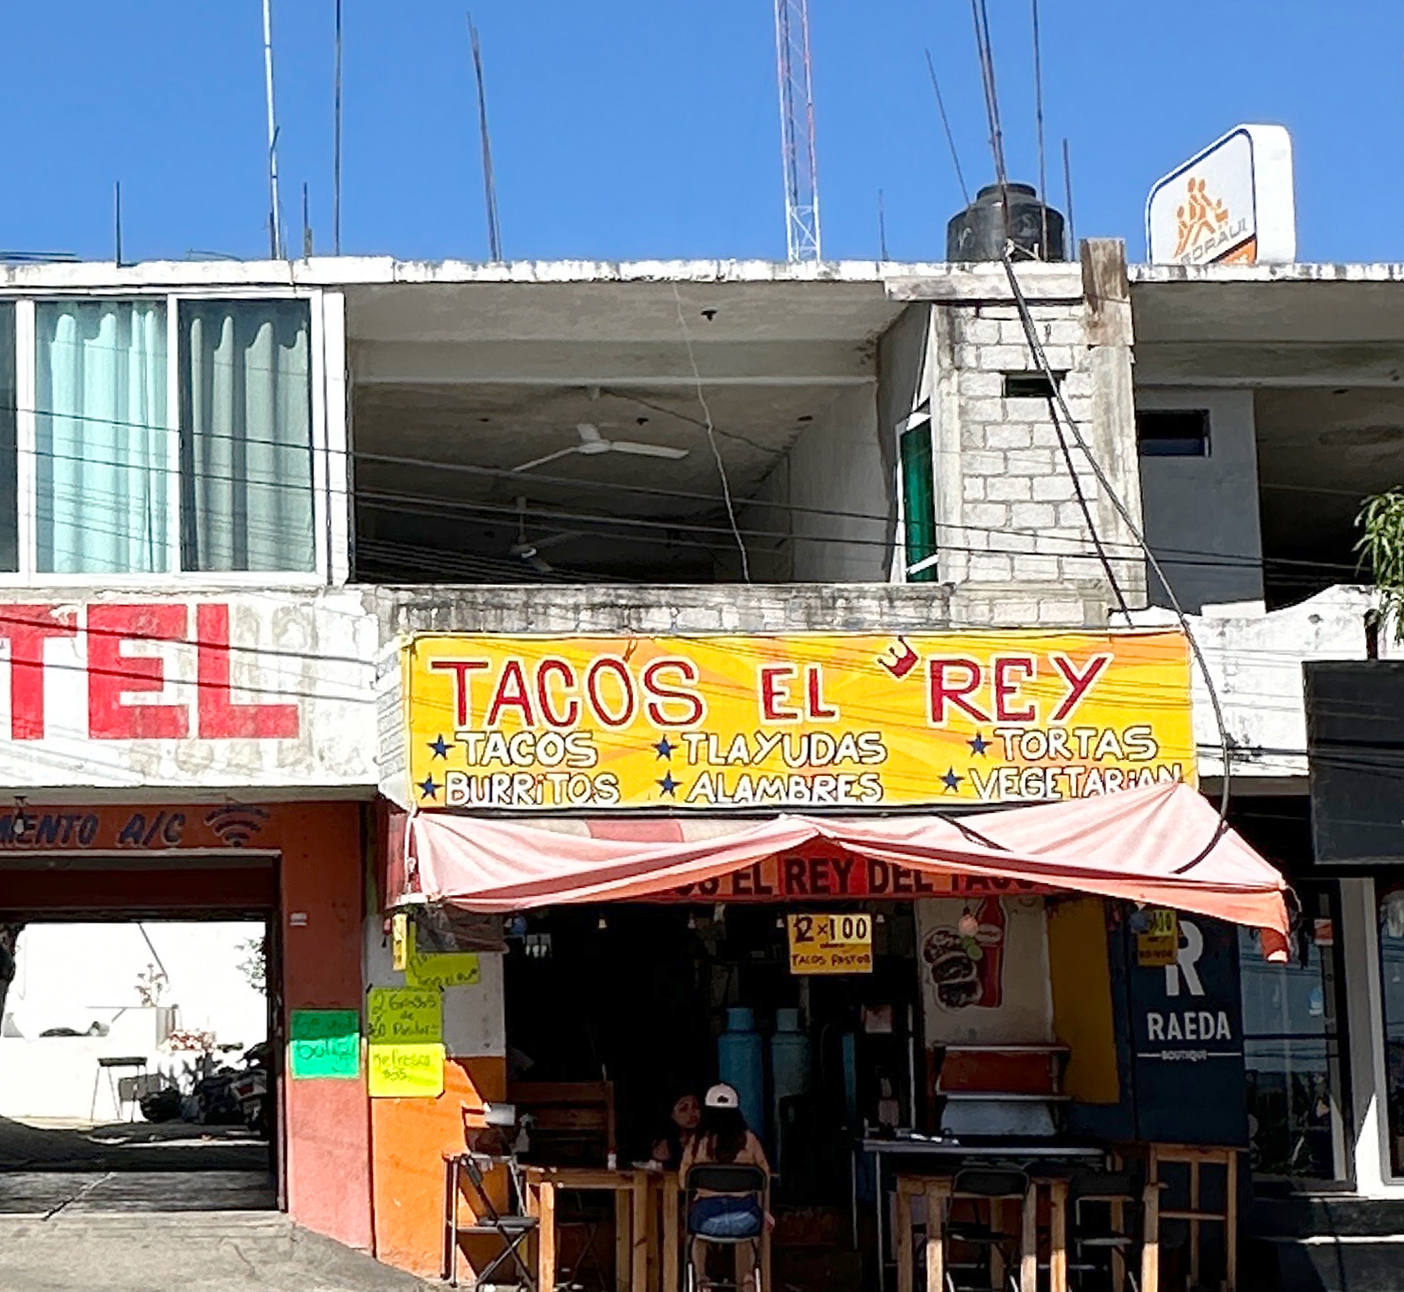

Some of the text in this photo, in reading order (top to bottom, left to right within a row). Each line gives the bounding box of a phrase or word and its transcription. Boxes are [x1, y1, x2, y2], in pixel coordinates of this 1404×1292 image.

[430, 658, 704, 727] TACOS
[760, 666, 837, 721] EL
[928, 656, 1112, 724] REY
[454, 725, 1160, 768] TACOS TLAYUDAS TORTAS
[685, 772, 885, 805] ALAMBRES
[118, 811, 186, 846] A/C
[732, 861, 773, 895] EL
[784, 858, 854, 895] REY
[867, 859, 934, 894] DEL
[792, 954, 871, 966] TACOS PASTOR
[1164, 919, 1205, 996] R
[1147, 1011, 1232, 1041] RAEDA
